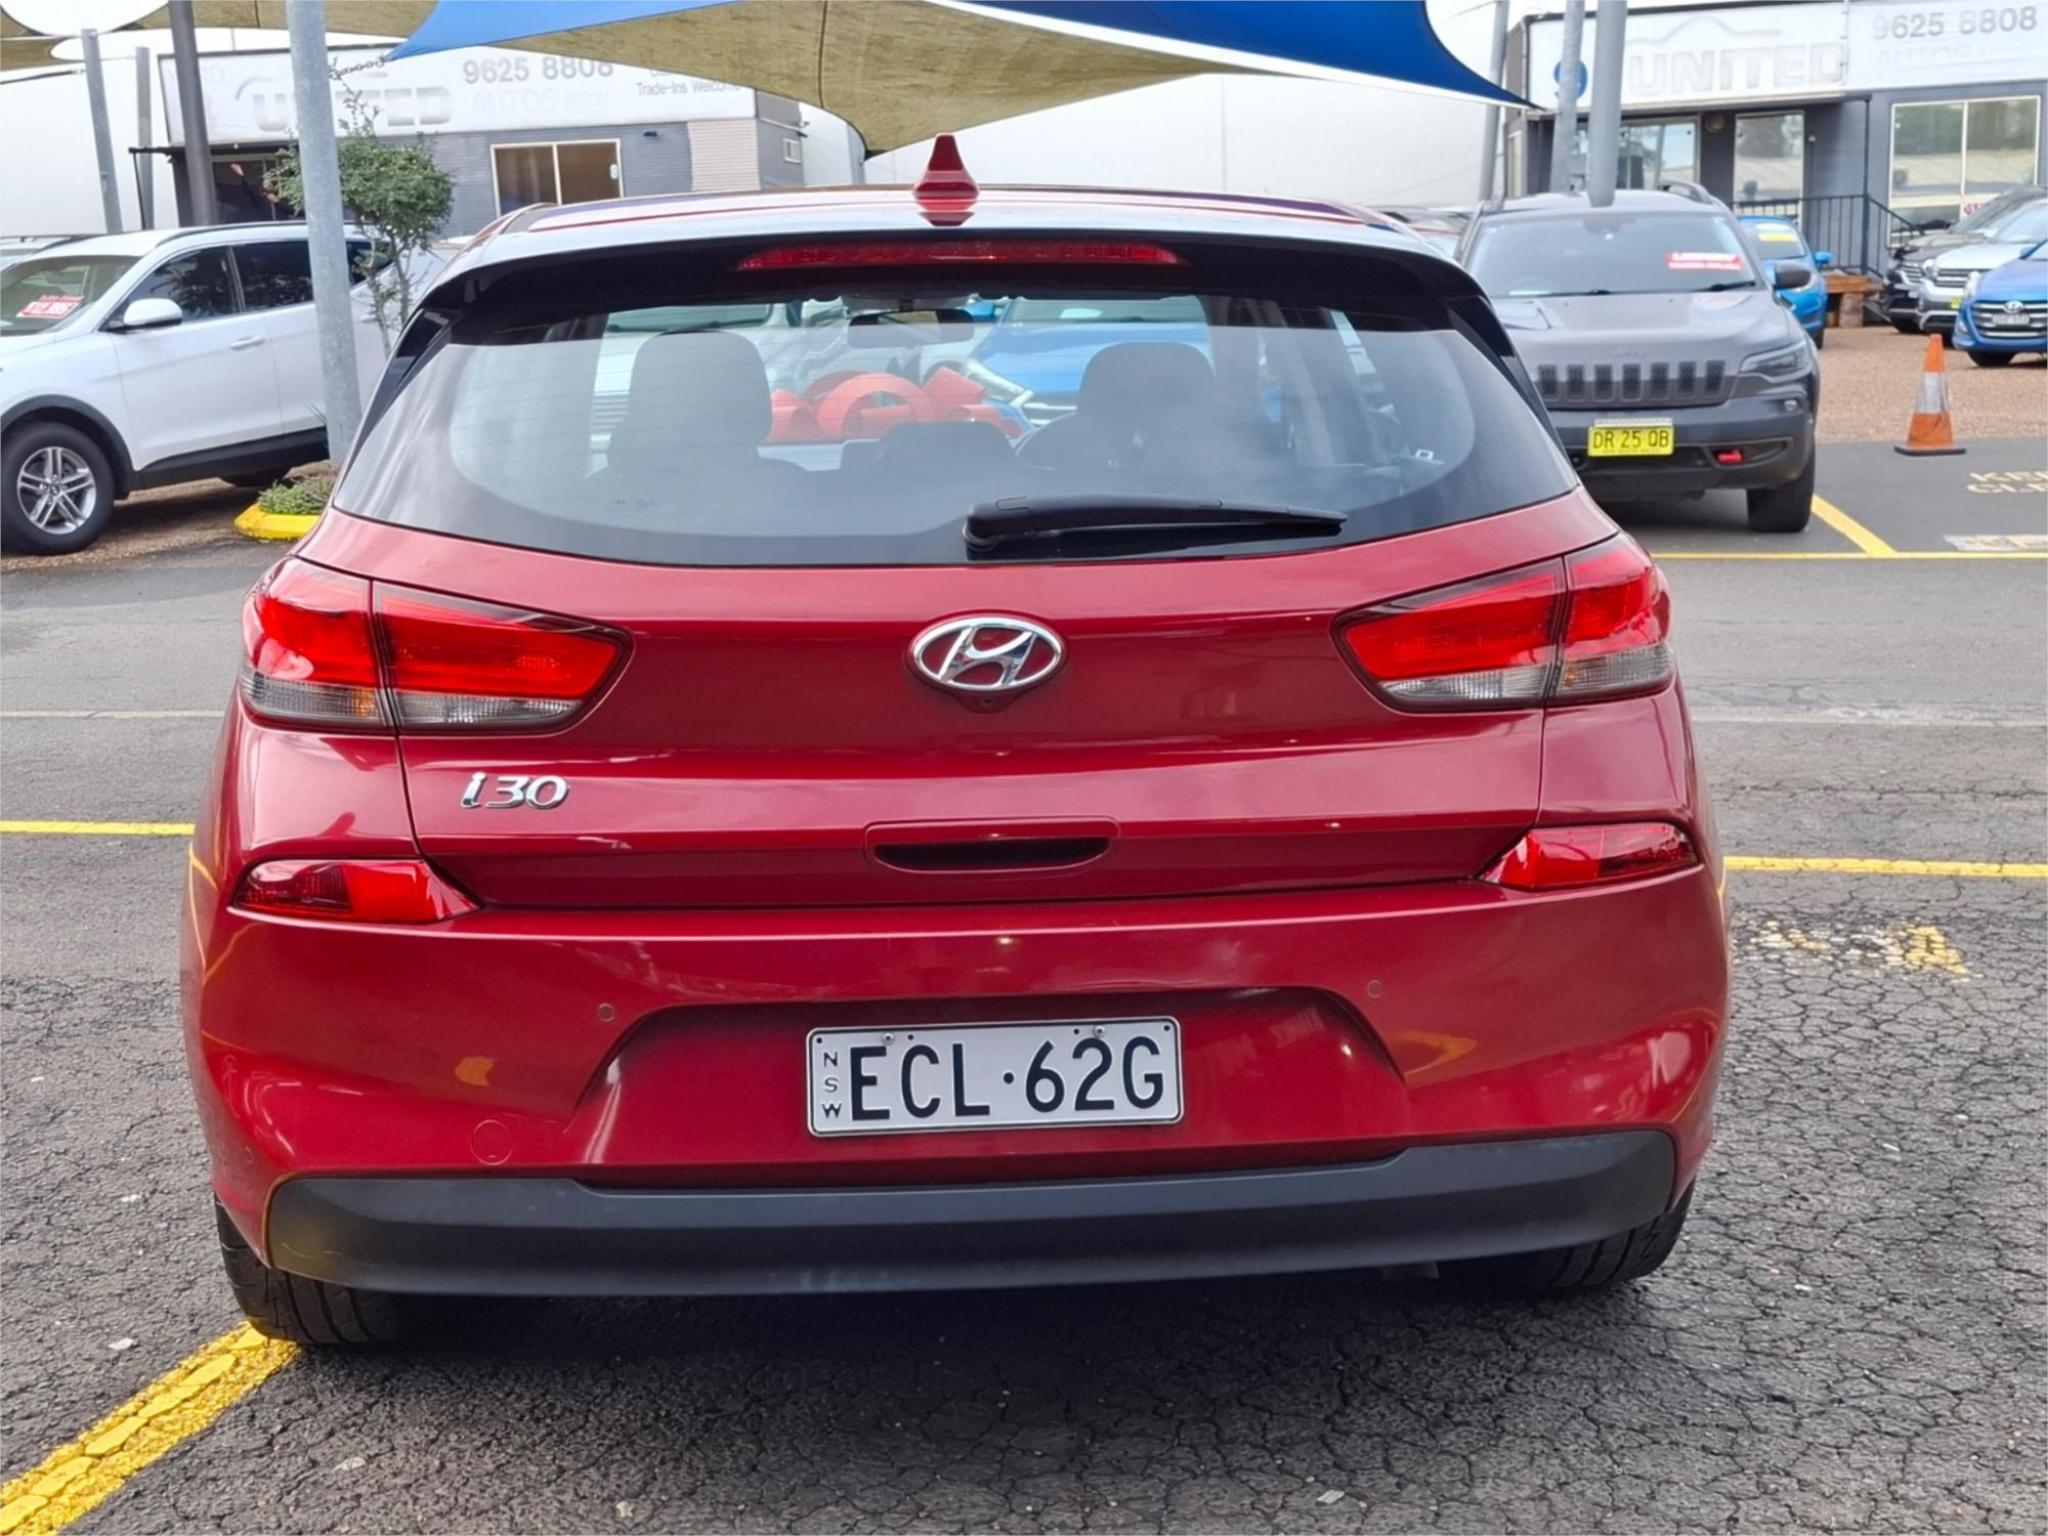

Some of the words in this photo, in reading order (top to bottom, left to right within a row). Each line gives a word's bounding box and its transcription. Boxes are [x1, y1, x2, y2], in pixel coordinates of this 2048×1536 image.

[1872, 13, 1945, 40] 9625
[1959, 5, 2038, 35] 8808
[462, 58, 529, 84] 9625
[1628, 42, 1843, 96] UNITED
[1593, 431, 1615, 449] DR
[1620, 430, 1642, 448] 25
